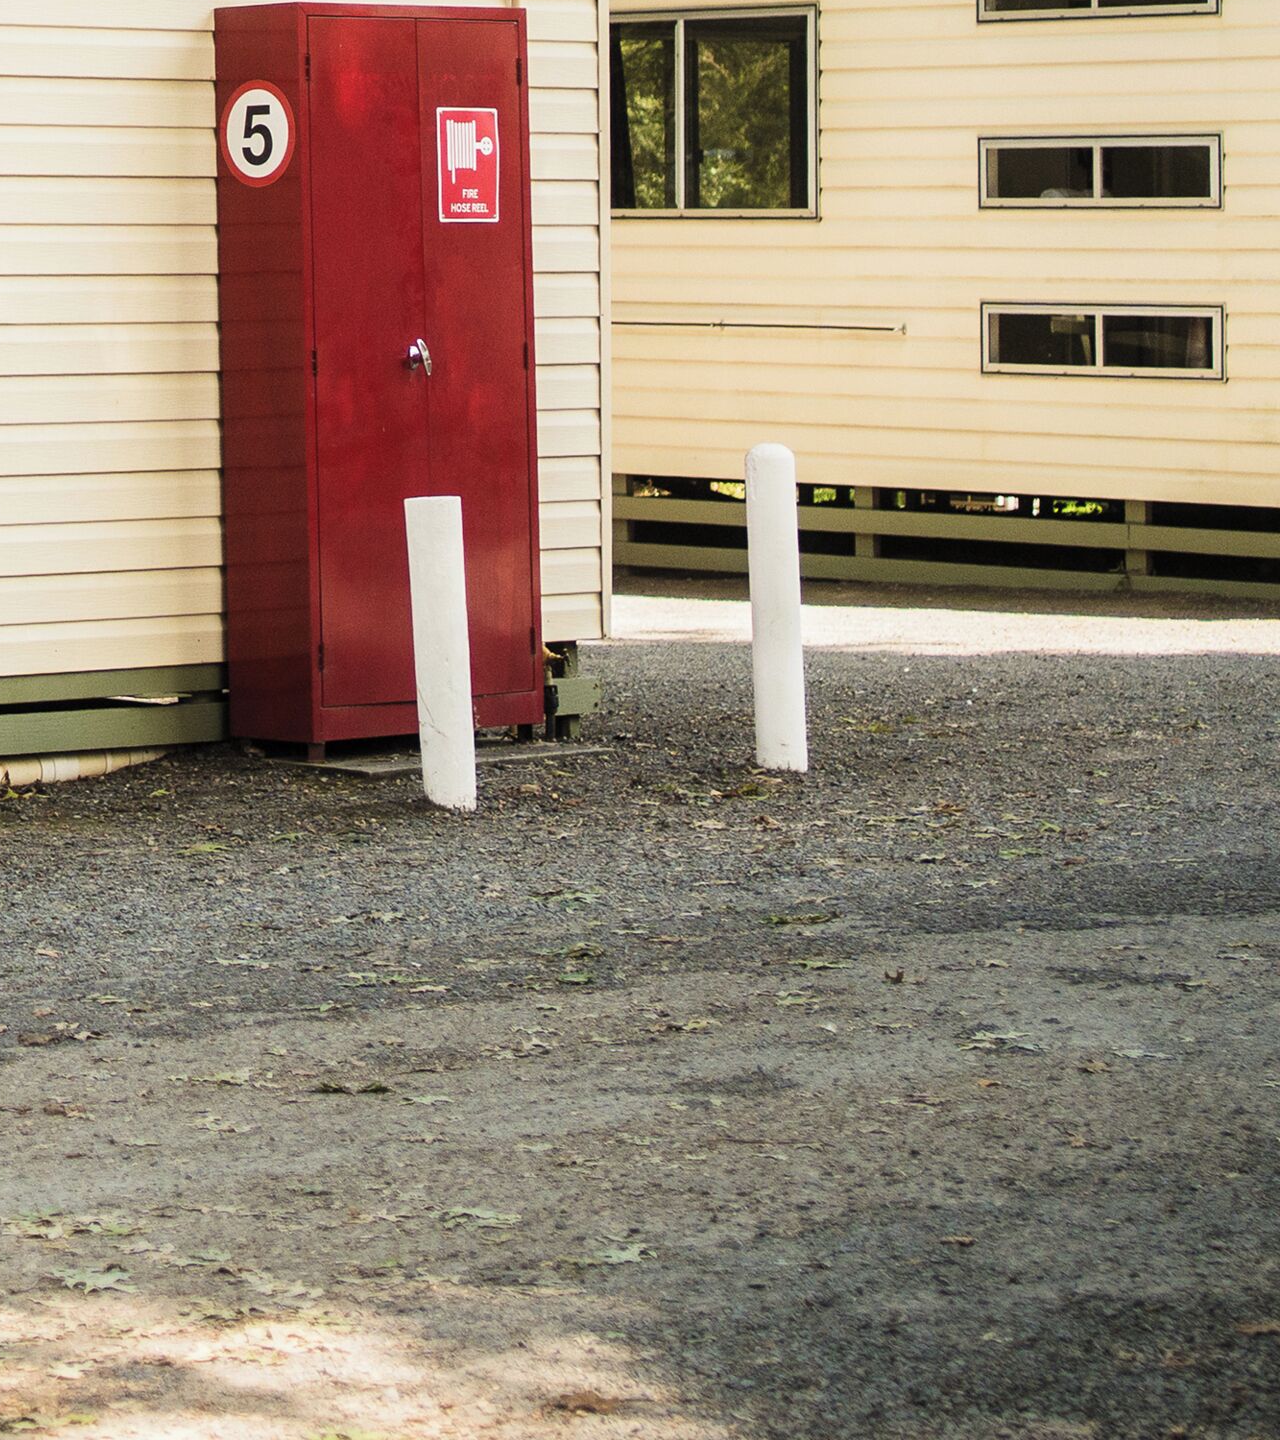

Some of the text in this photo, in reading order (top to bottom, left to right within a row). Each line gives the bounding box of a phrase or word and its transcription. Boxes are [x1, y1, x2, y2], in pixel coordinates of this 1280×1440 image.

[242, 105, 273, 166] 5
[462, 188, 478, 199] FIRE
[450, 202, 489, 213] HOSE REEL
